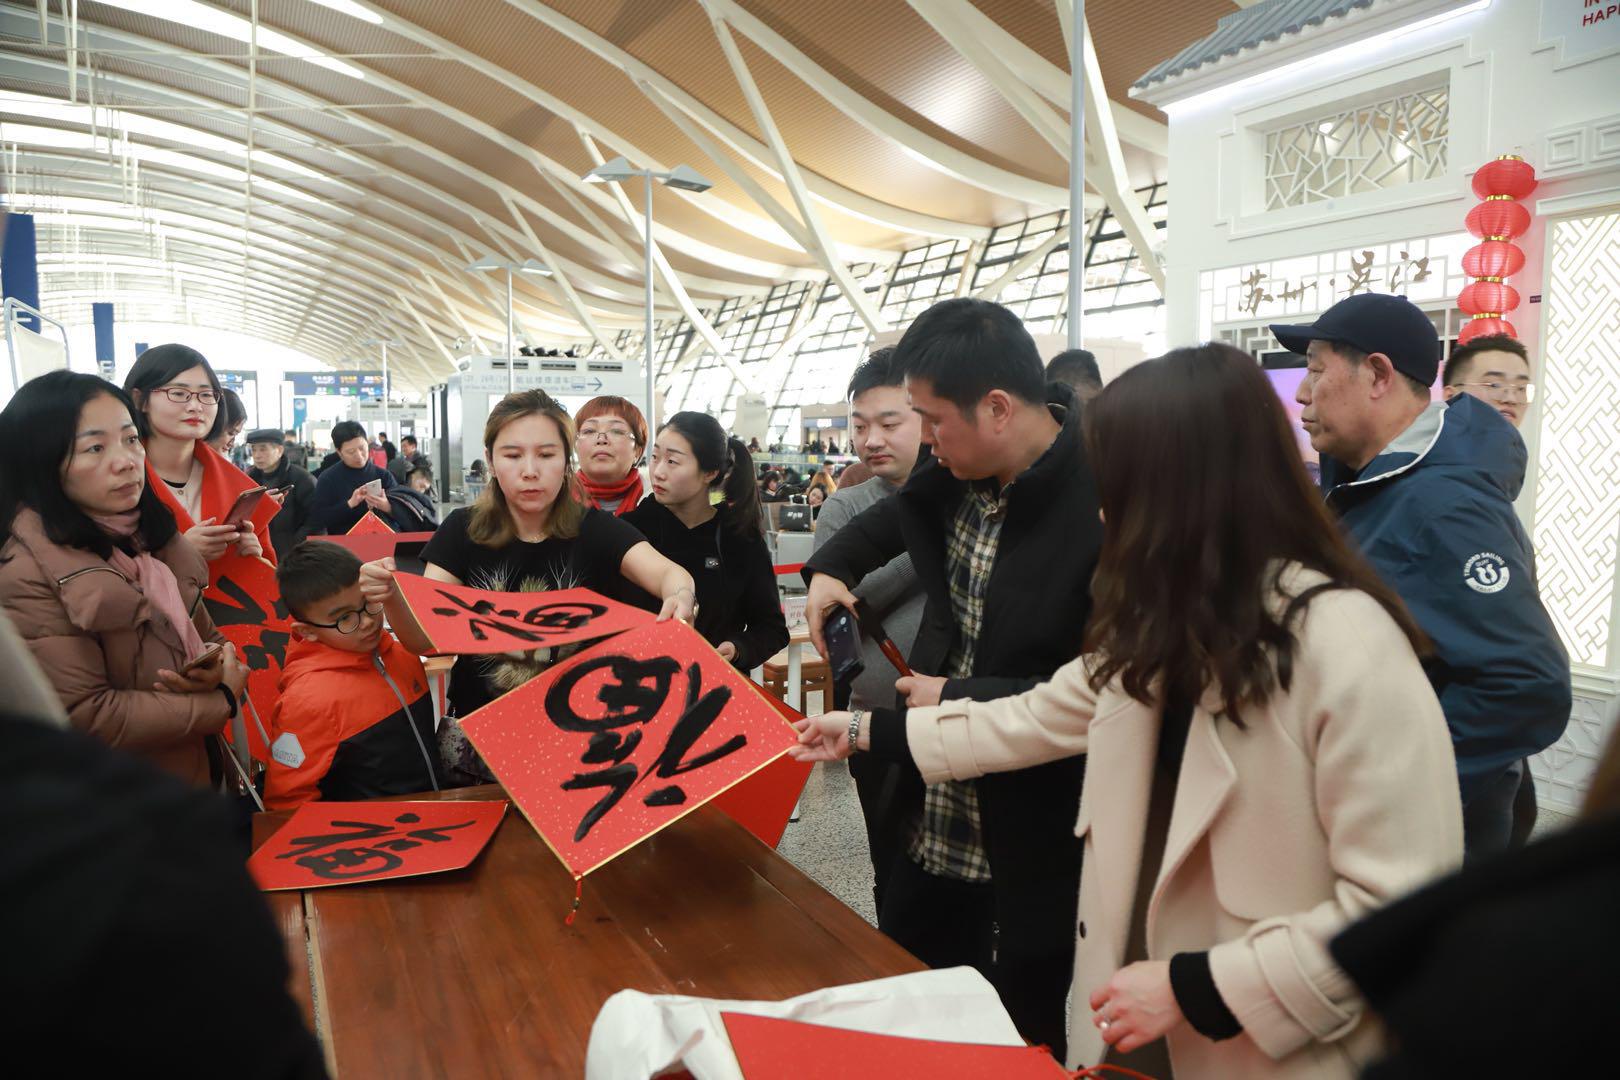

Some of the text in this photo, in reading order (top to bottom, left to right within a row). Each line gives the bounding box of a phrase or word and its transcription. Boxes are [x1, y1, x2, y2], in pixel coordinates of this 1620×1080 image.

[431, 588, 609, 642] 福
[545, 655, 747, 843] 福
[275, 813, 476, 879] 福
